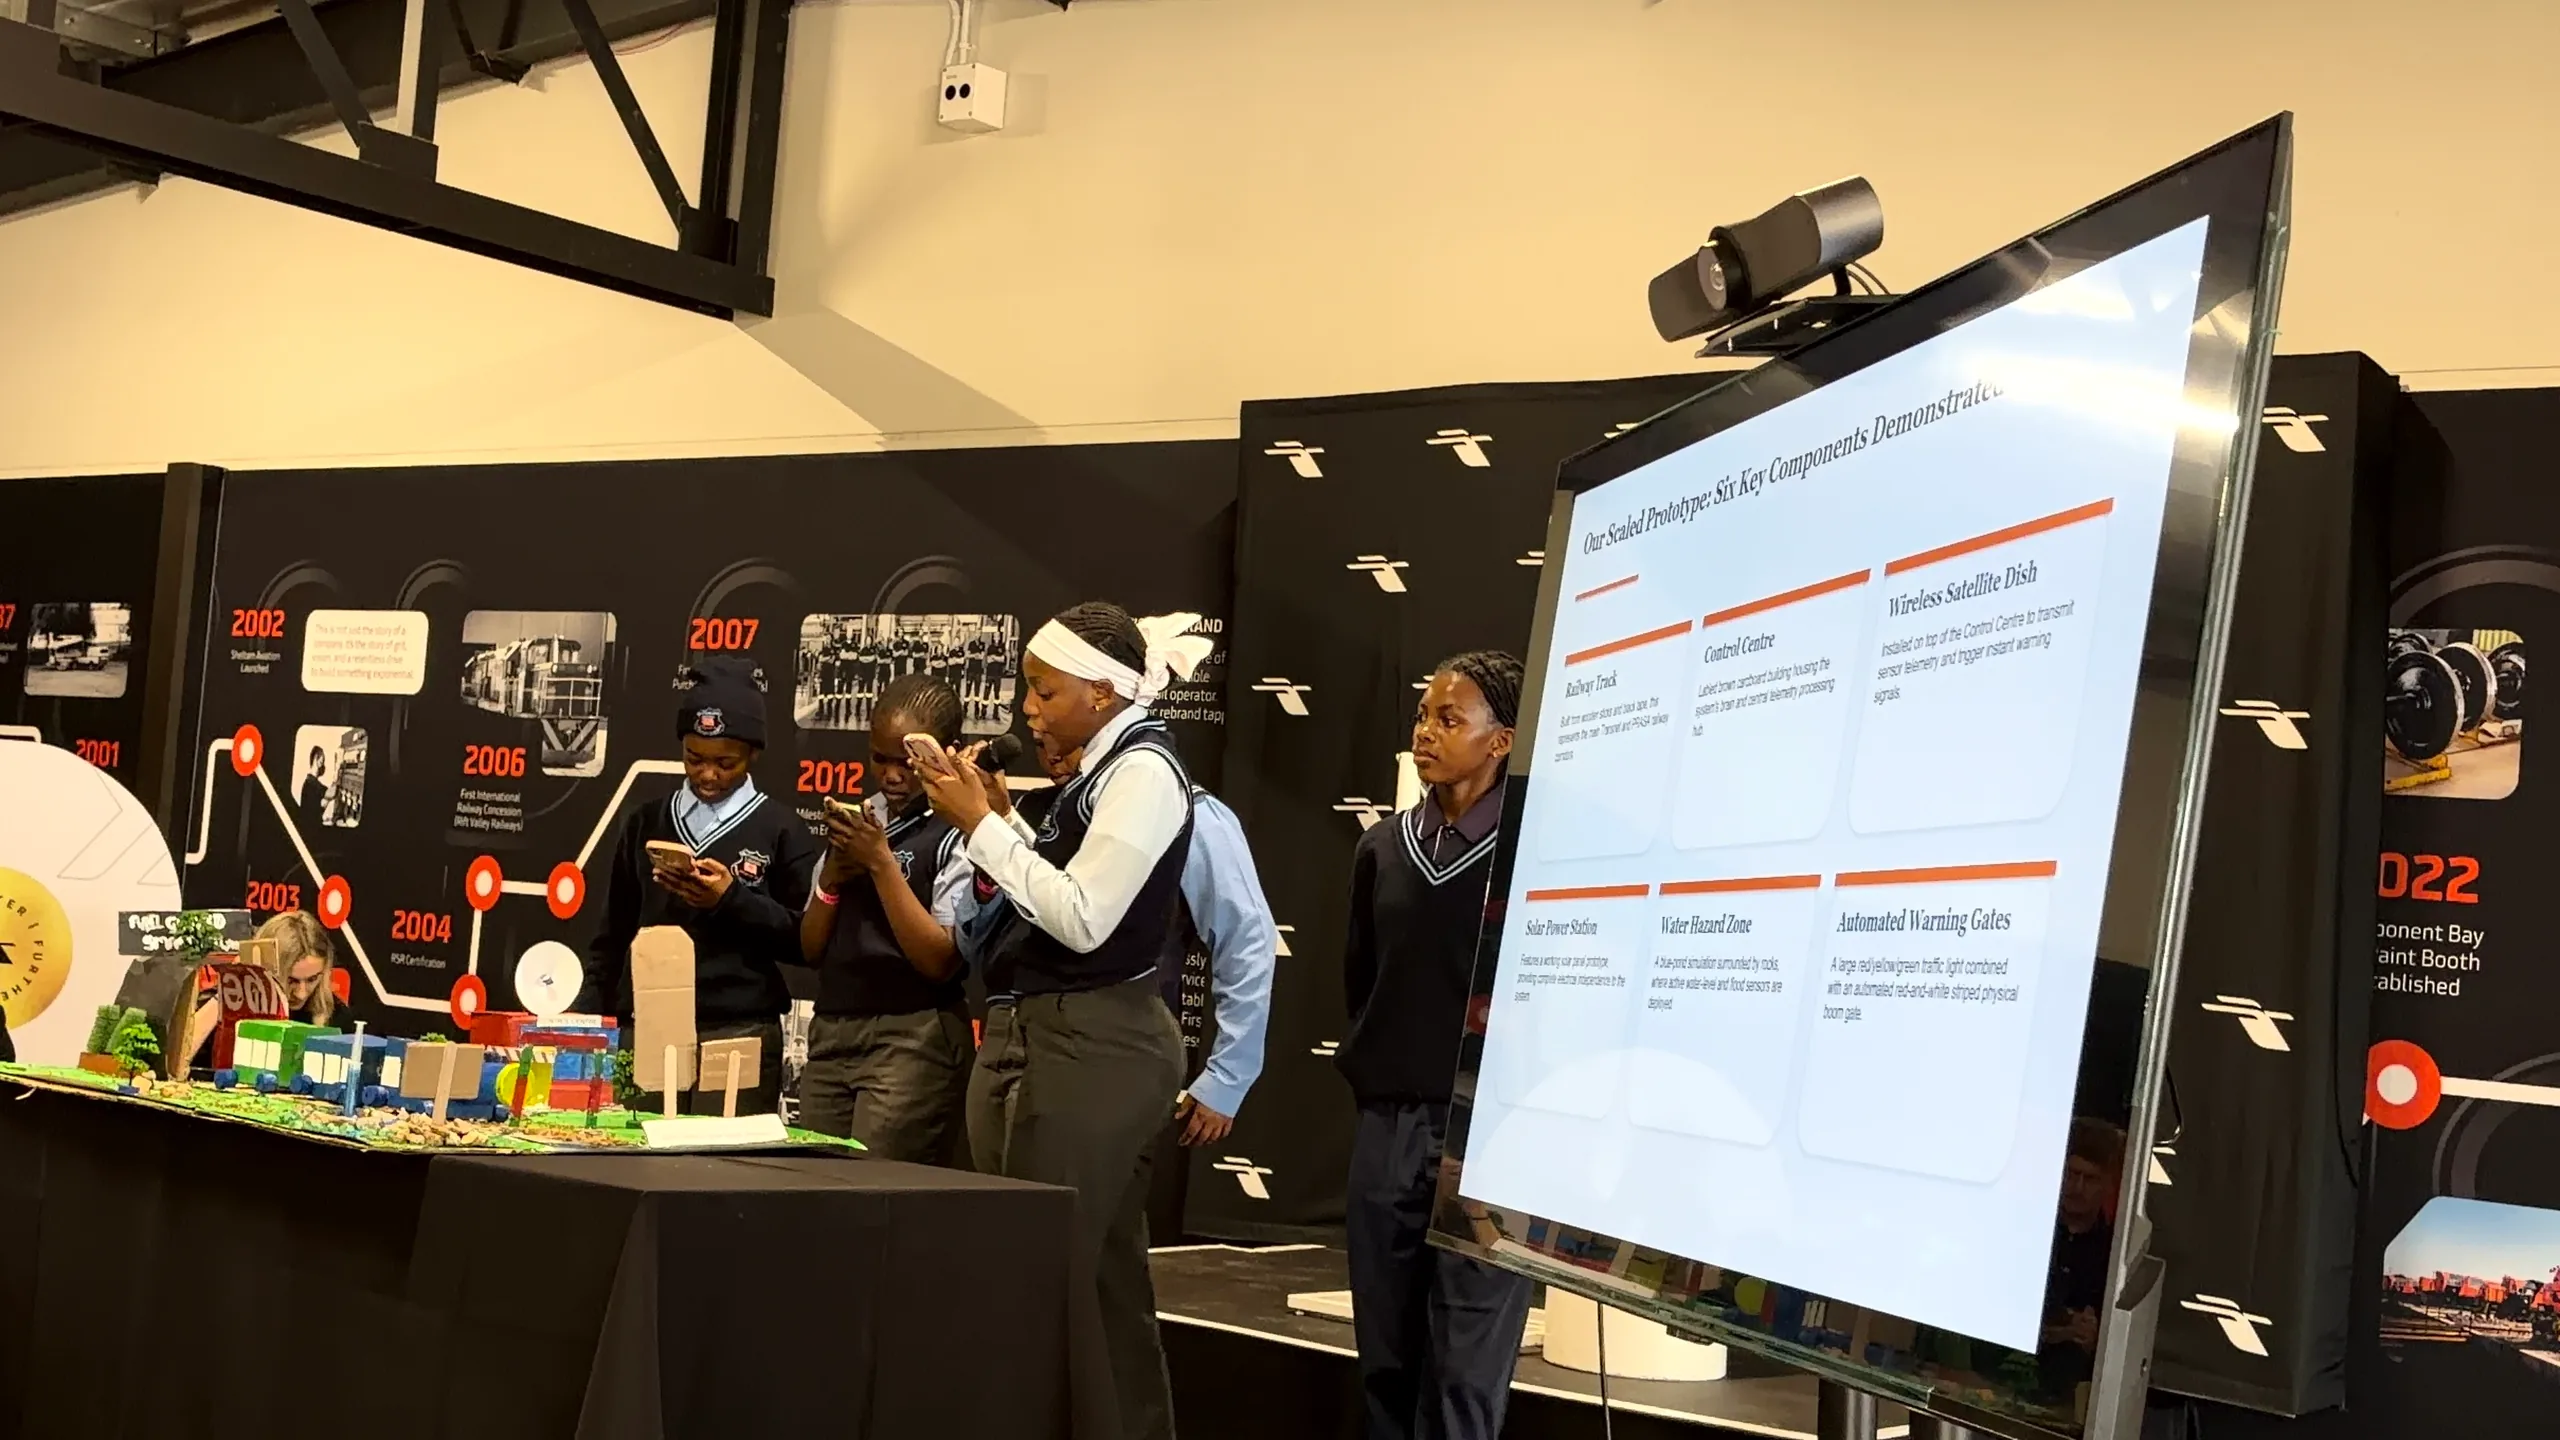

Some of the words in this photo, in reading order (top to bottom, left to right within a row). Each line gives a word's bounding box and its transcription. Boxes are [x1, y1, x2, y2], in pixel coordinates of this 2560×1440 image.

[1584, 531, 1605, 554] Our
[1606, 509, 1645, 546] Scaled
[1645, 491, 1711, 532] Prototype:
[1714, 475, 1736, 505] Six
[1738, 468, 1767, 497] Key
[1769, 427, 1868, 482] Components
[1890, 589, 1943, 617] Wireless
[1945, 572, 2001, 604] Satellite
[2004, 560, 2037, 589] Dish
[231, 609, 285, 638] 2002
[690, 618, 759, 650] 2007
[1881, 636, 1913, 657] Installed
[1914, 637, 1924, 650] on
[1925, 633, 1936, 649] top
[1939, 627, 1948, 644] of
[1949, 624, 1962, 641] the
[1963, 618, 1994, 639] Control
[1995, 612, 2025, 632] Centre
[2026, 609, 2036, 625] to
[2037, 600, 2074, 623] transmit
[1214, 651, 1226, 664] of
[1705, 637, 1741, 663] Control
[1742, 633, 1775, 654] Centre
[1877, 664, 1902, 680] sensor
[1904, 654, 1939, 674] telemetry
[1940, 649, 1956, 667] and
[1957, 645, 1984, 666] trigger
[1985, 638, 2015, 657] instant
[2016, 632, 2051, 651] warning
[1793, 660, 1818, 676] housing
[1820, 657, 1830, 671] the
[1566, 679, 1594, 698] Railway
[1596, 670, 1617, 691] Track
[1160, 706, 1201, 720] rebrand
[76, 739, 120, 768] 2001
[464, 745, 526, 777] 2006
[797, 760, 864, 794] 2012
[460, 788, 475, 800] First
[477, 790, 520, 802] International
[457, 801, 482, 816] Railway
[484, 804, 522, 817] Concession
[470, 818, 490, 831] Valley
[491, 819, 523, 833] Railways)
[2378, 852, 2479, 903] 022
[0, 895, 27, 916] ER
[245, 881, 300, 912] 2003
[392, 910, 451, 944] 2004
[1525, 918, 1545, 936] Solar
[1545, 920, 1569, 936] Power
[1570, 917, 1598, 935] Station
[1661, 916, 1689, 934] Water
[1690, 913, 1726, 934] Hazard
[1726, 914, 1752, 934] Zone
[1836, 908, 1906, 932] Automated
[1910, 907, 1968, 937] Warning
[1971, 908, 2011, 931] Gates
[2449, 924, 2484, 949] Bay
[0, 939, 44, 1002] FURTHE
[406, 954, 446, 968] Certification
[1752, 956, 1759, 973] by
[1830, 957, 1836, 972] A
[1838, 957, 1856, 975] large
[1921, 957, 1944, 974] traffic
[1945, 957, 1964, 978] light
[1965, 958, 2009, 975] combined
[2376, 947, 2416, 966] aint
[2422, 949, 2480, 971] Booth
[1717, 978, 1729, 991] and
[1730, 976, 1746, 992] flood
[1745, 981, 1771, 992] sensors
[1771, 981, 1782, 992] are
[1827, 980, 1842, 994] with
[1843, 983, 1852, 995] an
[1853, 981, 1895, 997] automated
[1895, 982, 1949, 1000] red-and-white
[1950, 984, 1982, 1003] striped
[1982, 984, 2020, 1004] physical
[2374, 973, 2460, 996] ablished
[1181, 1011, 1201, 1028] Firs
[1823, 1004, 1843, 1020] boom
